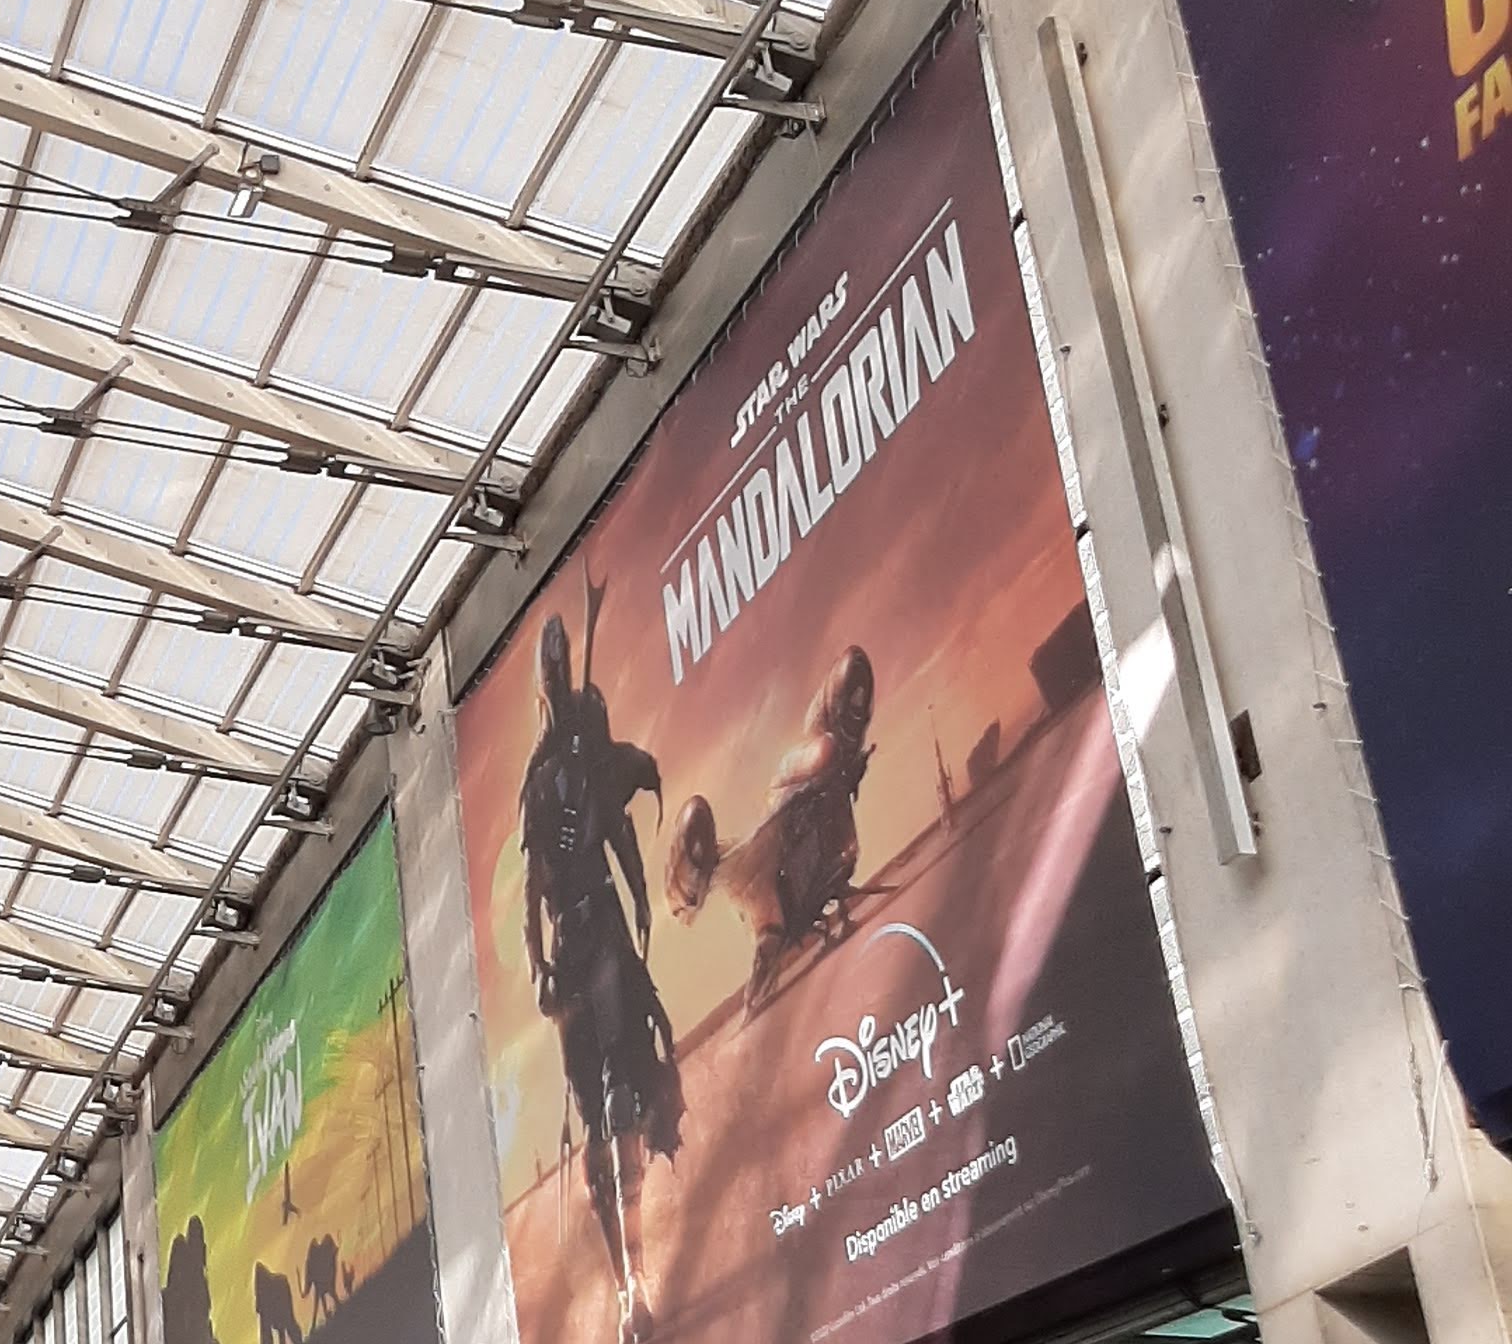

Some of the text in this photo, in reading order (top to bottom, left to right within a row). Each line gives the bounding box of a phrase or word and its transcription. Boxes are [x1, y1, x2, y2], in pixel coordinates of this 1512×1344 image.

[731, 271, 848, 448] STAR WARS
[775, 374, 809, 423] THE
[661, 219, 976, 685] MANDALORIAN
[825, 1158, 864, 1196] PIXAR
[846, 1198, 918, 1261] Disponible
[921, 1186, 940, 1212] en
[942, 1136, 1017, 1199] streaming
